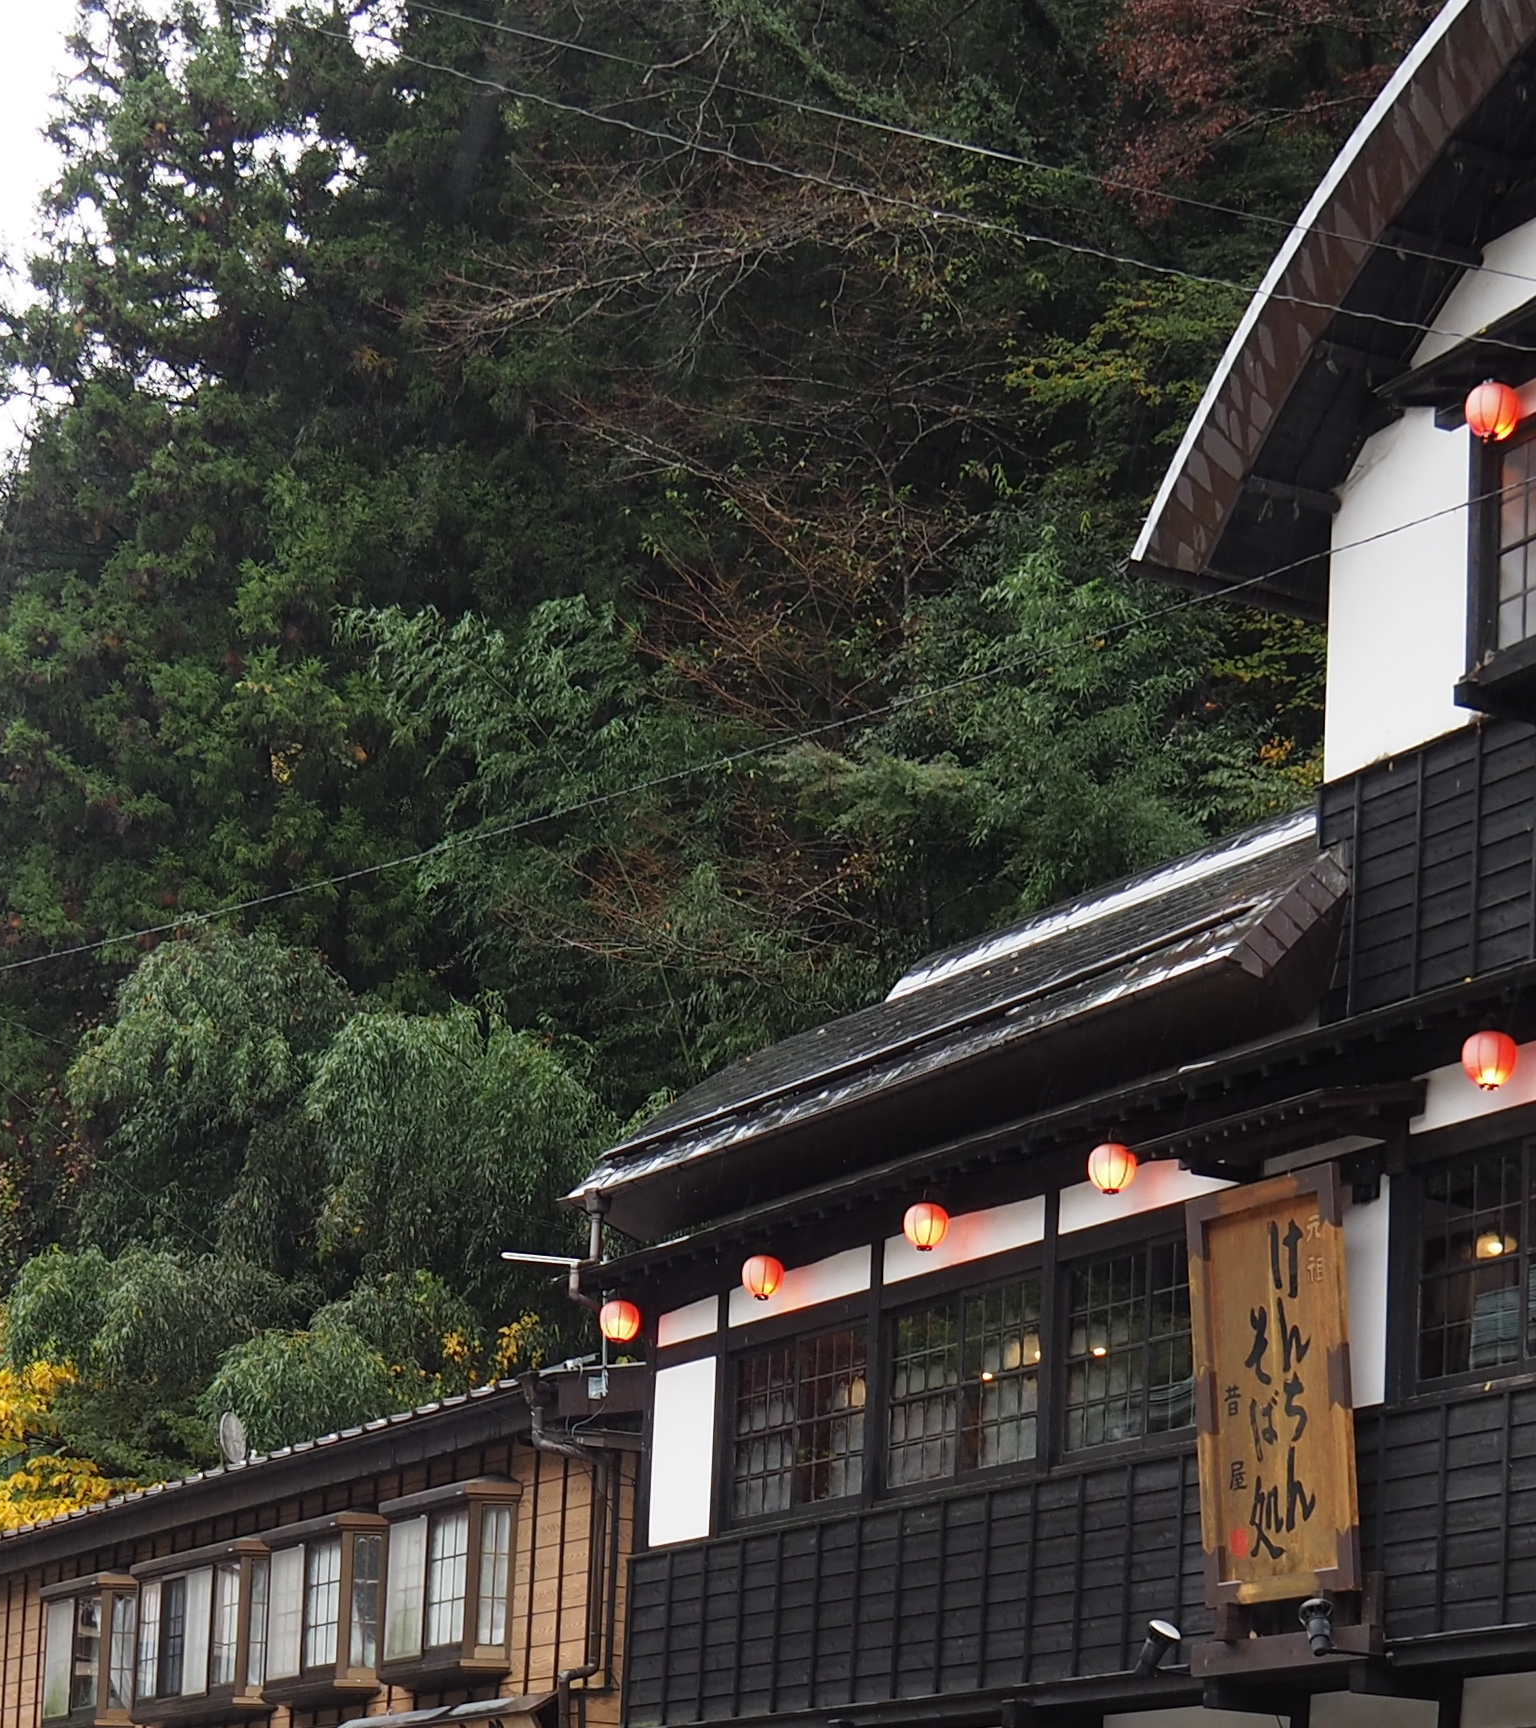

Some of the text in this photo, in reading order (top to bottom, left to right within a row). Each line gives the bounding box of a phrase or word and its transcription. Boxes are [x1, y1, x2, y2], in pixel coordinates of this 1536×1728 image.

[1306, 1214, 1324, 1284] 元祖
[1224, 1384, 1248, 1491] 昔屋
[1244, 1306, 1286, 1560] そば処
[1270, 1217, 1316, 1534] けんちん
